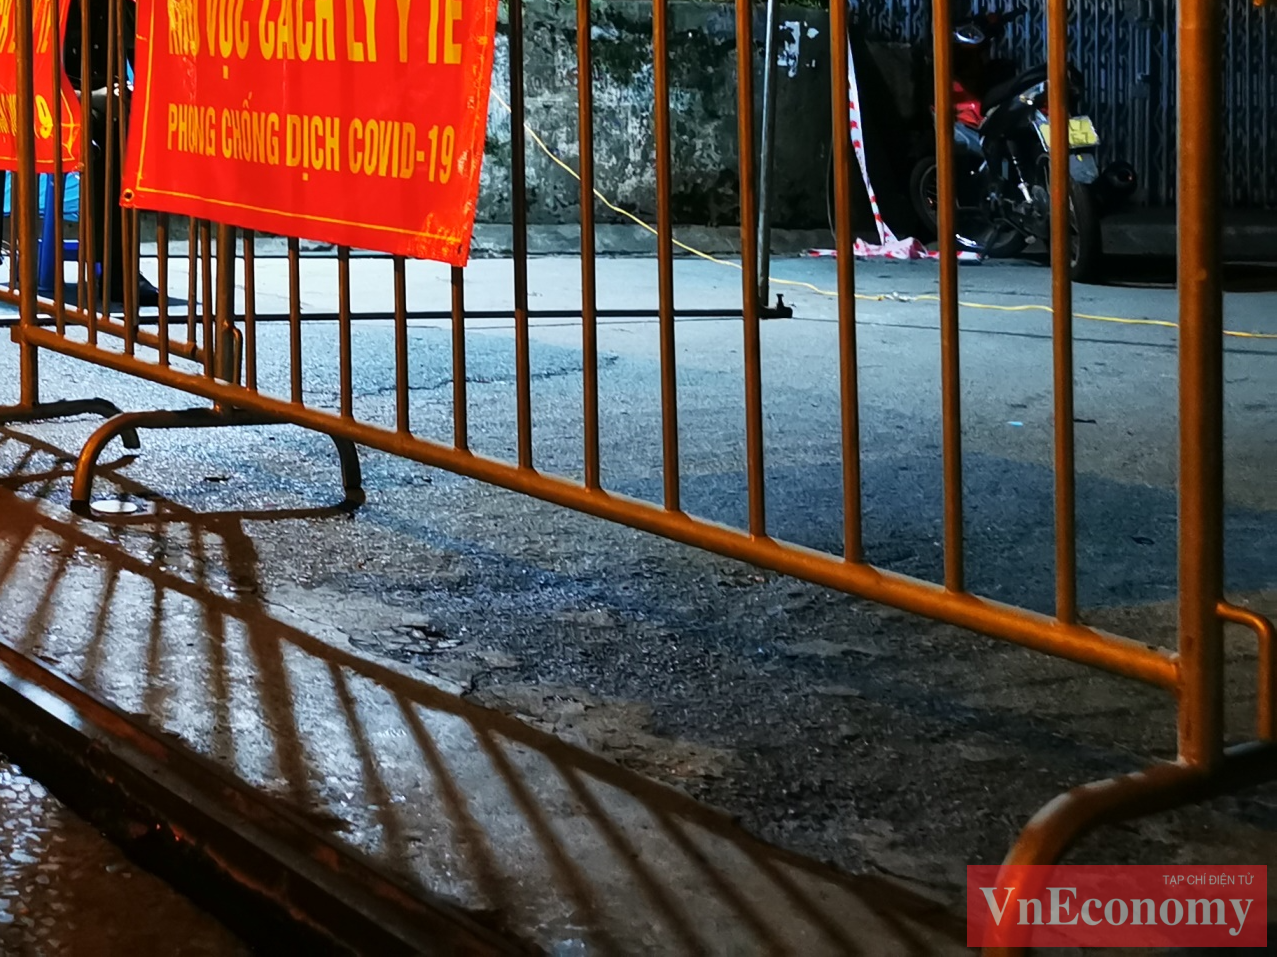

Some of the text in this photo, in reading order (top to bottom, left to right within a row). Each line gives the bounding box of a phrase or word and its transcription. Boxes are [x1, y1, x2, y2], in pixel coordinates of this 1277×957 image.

[221, 91, 280, 166] CHỐNG
[285, 112, 341, 182] DỊCH
[348, 117, 456, 185] COVID-19
